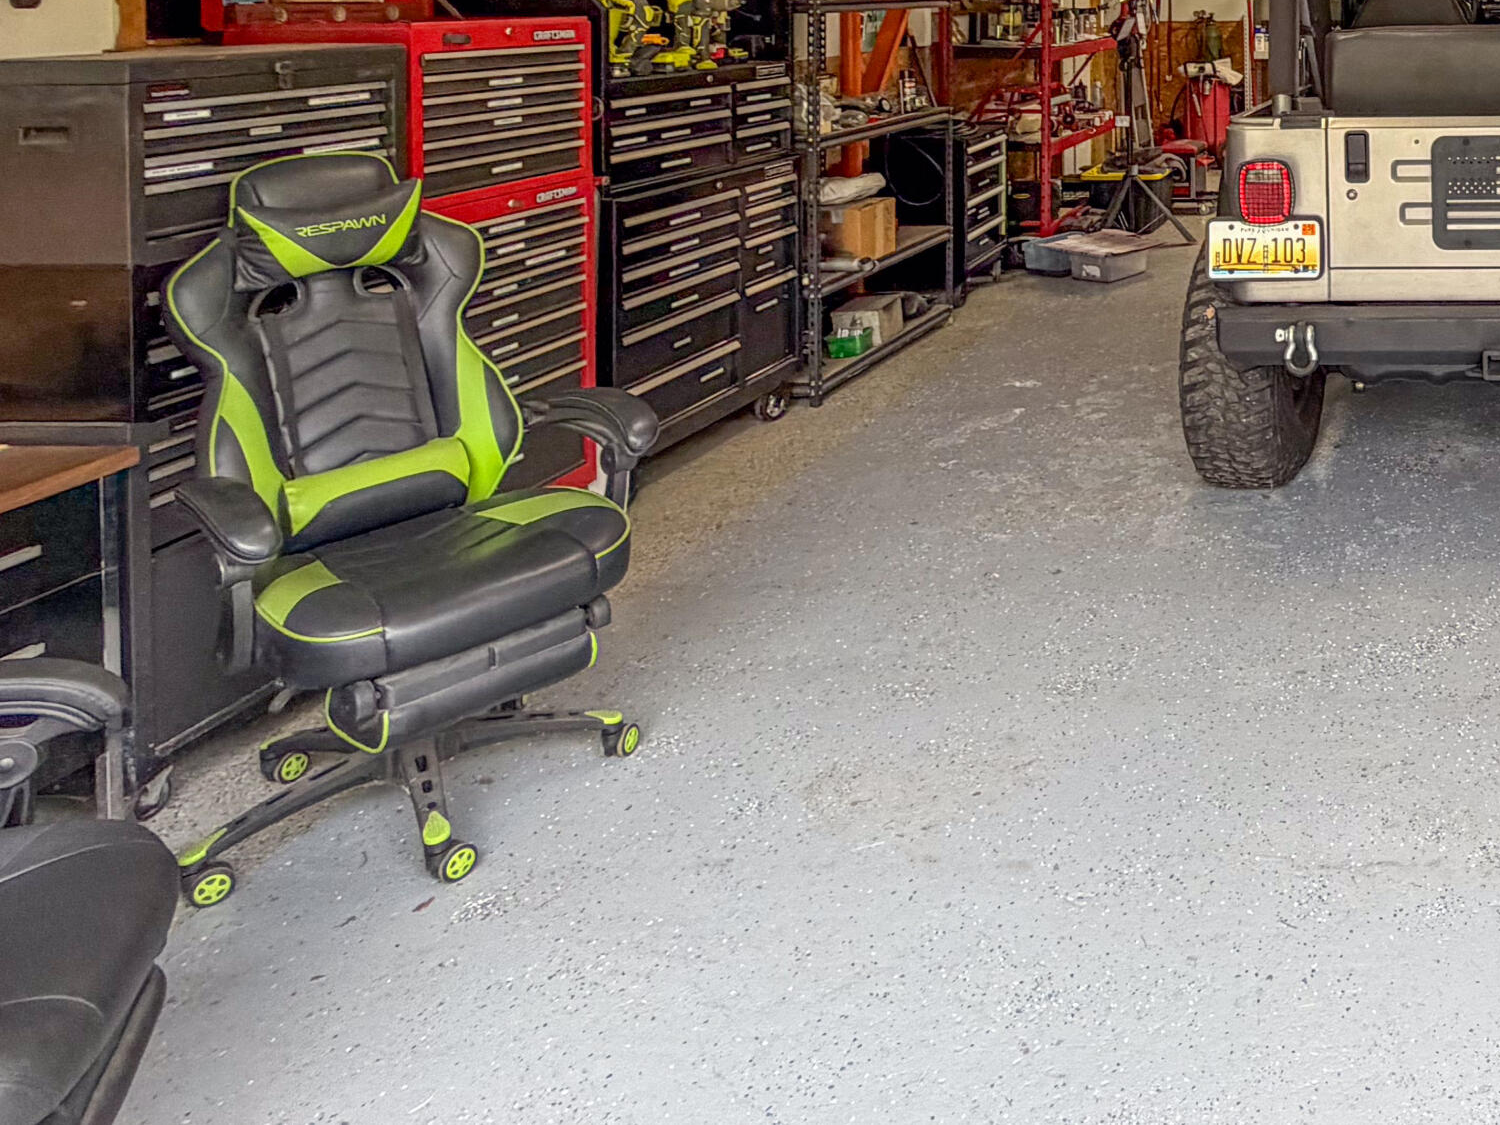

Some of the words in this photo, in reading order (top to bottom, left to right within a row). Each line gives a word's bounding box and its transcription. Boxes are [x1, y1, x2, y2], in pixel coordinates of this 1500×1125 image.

[294, 213, 387, 238] RESPAWN
[1221, 237, 1258, 265] DVZ
[1270, 237, 1307, 265] 103
